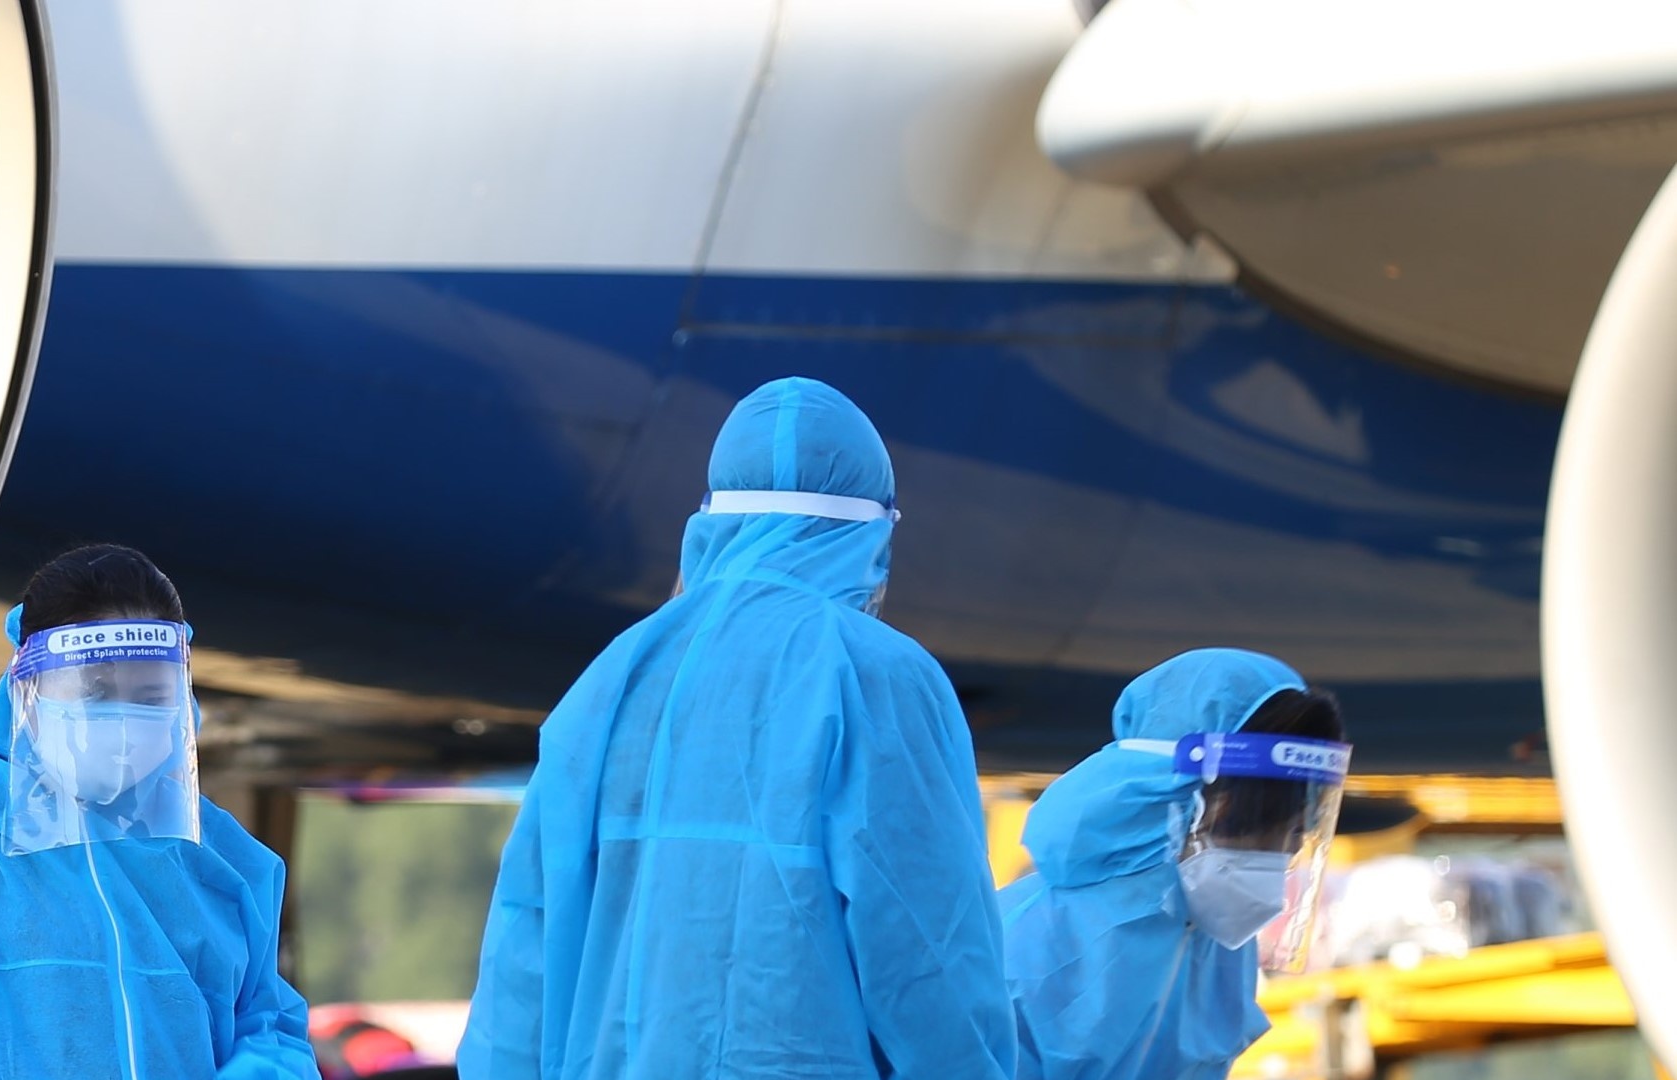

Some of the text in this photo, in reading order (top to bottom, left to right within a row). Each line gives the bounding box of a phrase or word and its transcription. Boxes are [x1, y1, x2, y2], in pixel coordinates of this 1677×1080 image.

[61, 628, 168, 648] Face shield
[64, 648, 168, 662] Direct Splash protection
[1284, 746, 1323, 765] Face
